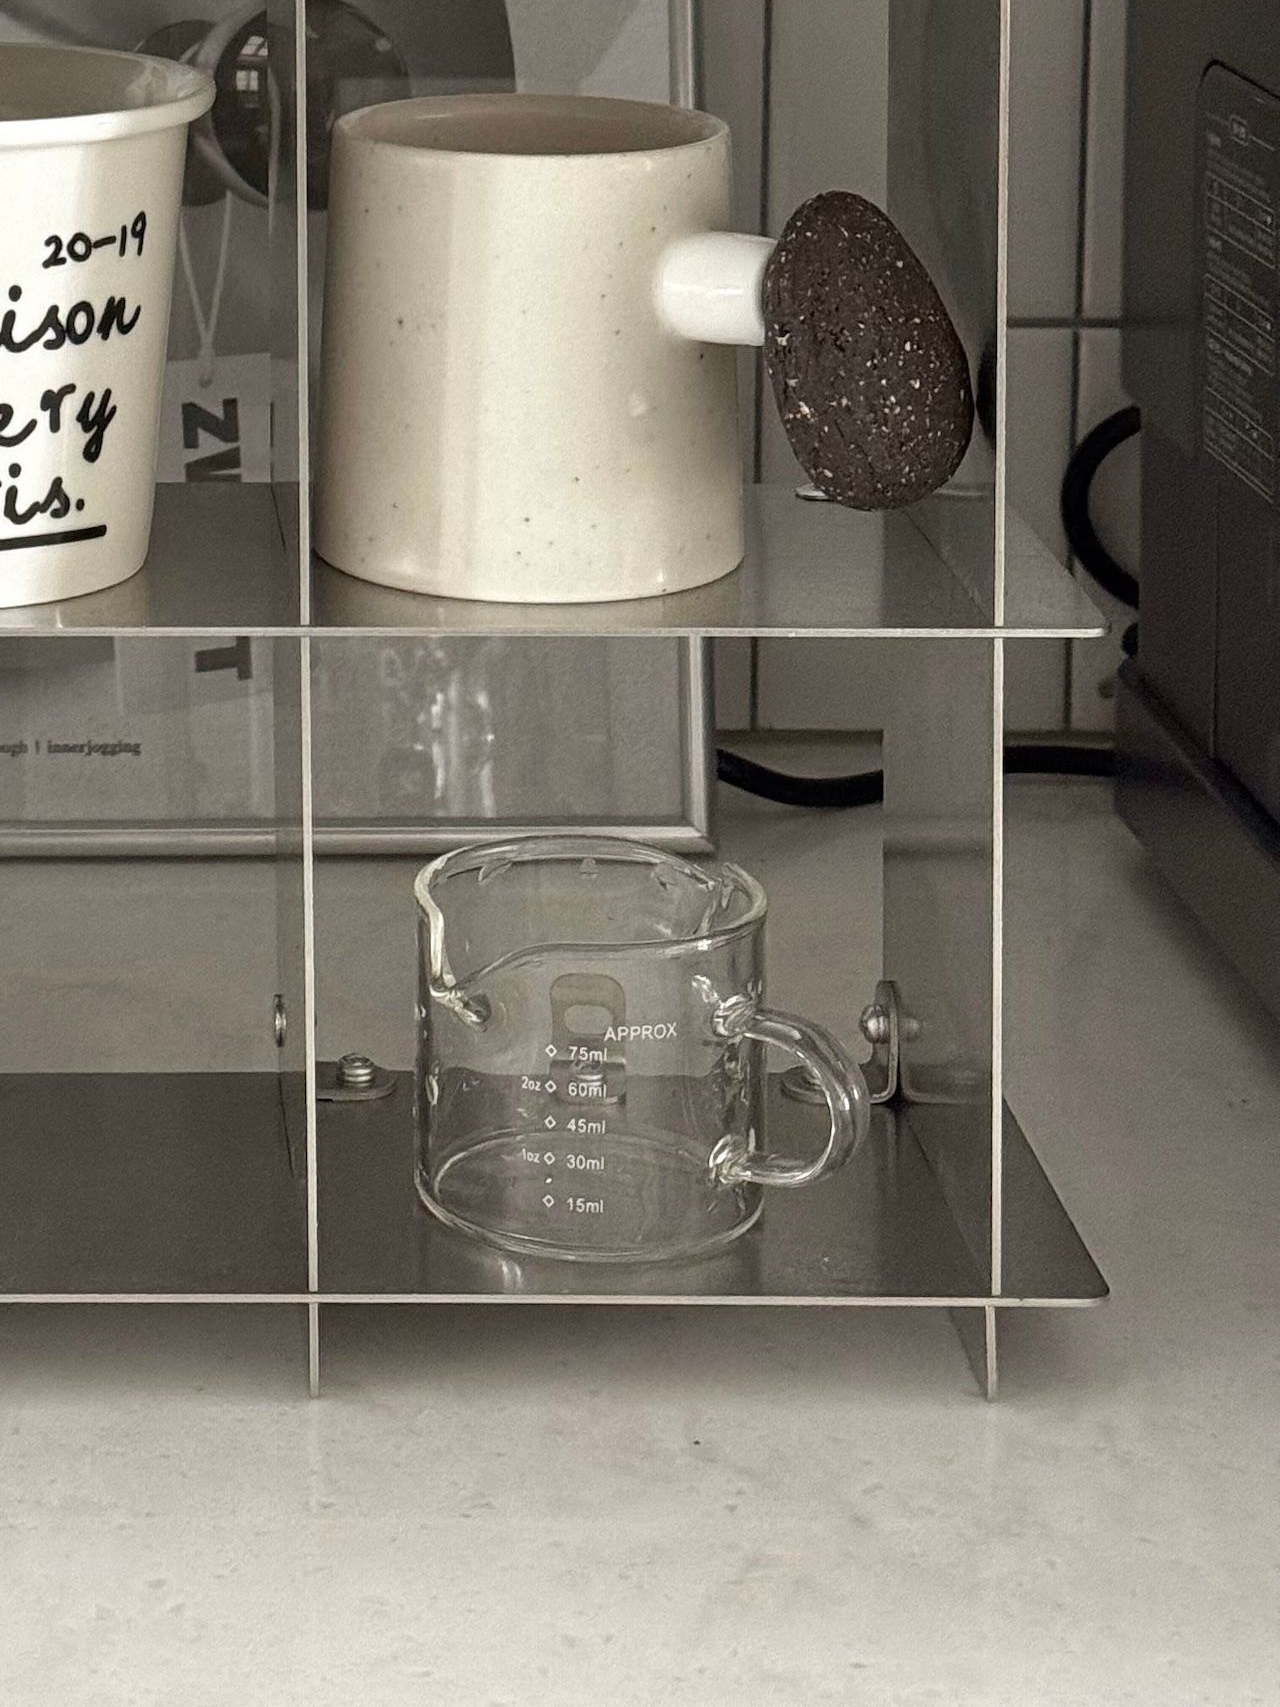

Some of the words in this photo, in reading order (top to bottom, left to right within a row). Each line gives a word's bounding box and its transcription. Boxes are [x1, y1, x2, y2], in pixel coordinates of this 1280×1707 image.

[43, 211, 147, 269] 20-19
[47, 739, 143, 757] innerjogging
[604, 1022, 677, 1041] APPROX
[568, 1046, 608, 1061] 75ml
[521, 1075, 541, 1091] 2oz
[568, 1082, 607, 1098] 60ml
[566, 1119, 606, 1134] 45ml
[521, 1148, 541, 1163] 1oz
[566, 1155, 605, 1170] 30ml
[566, 1197, 604, 1213] 15ml
